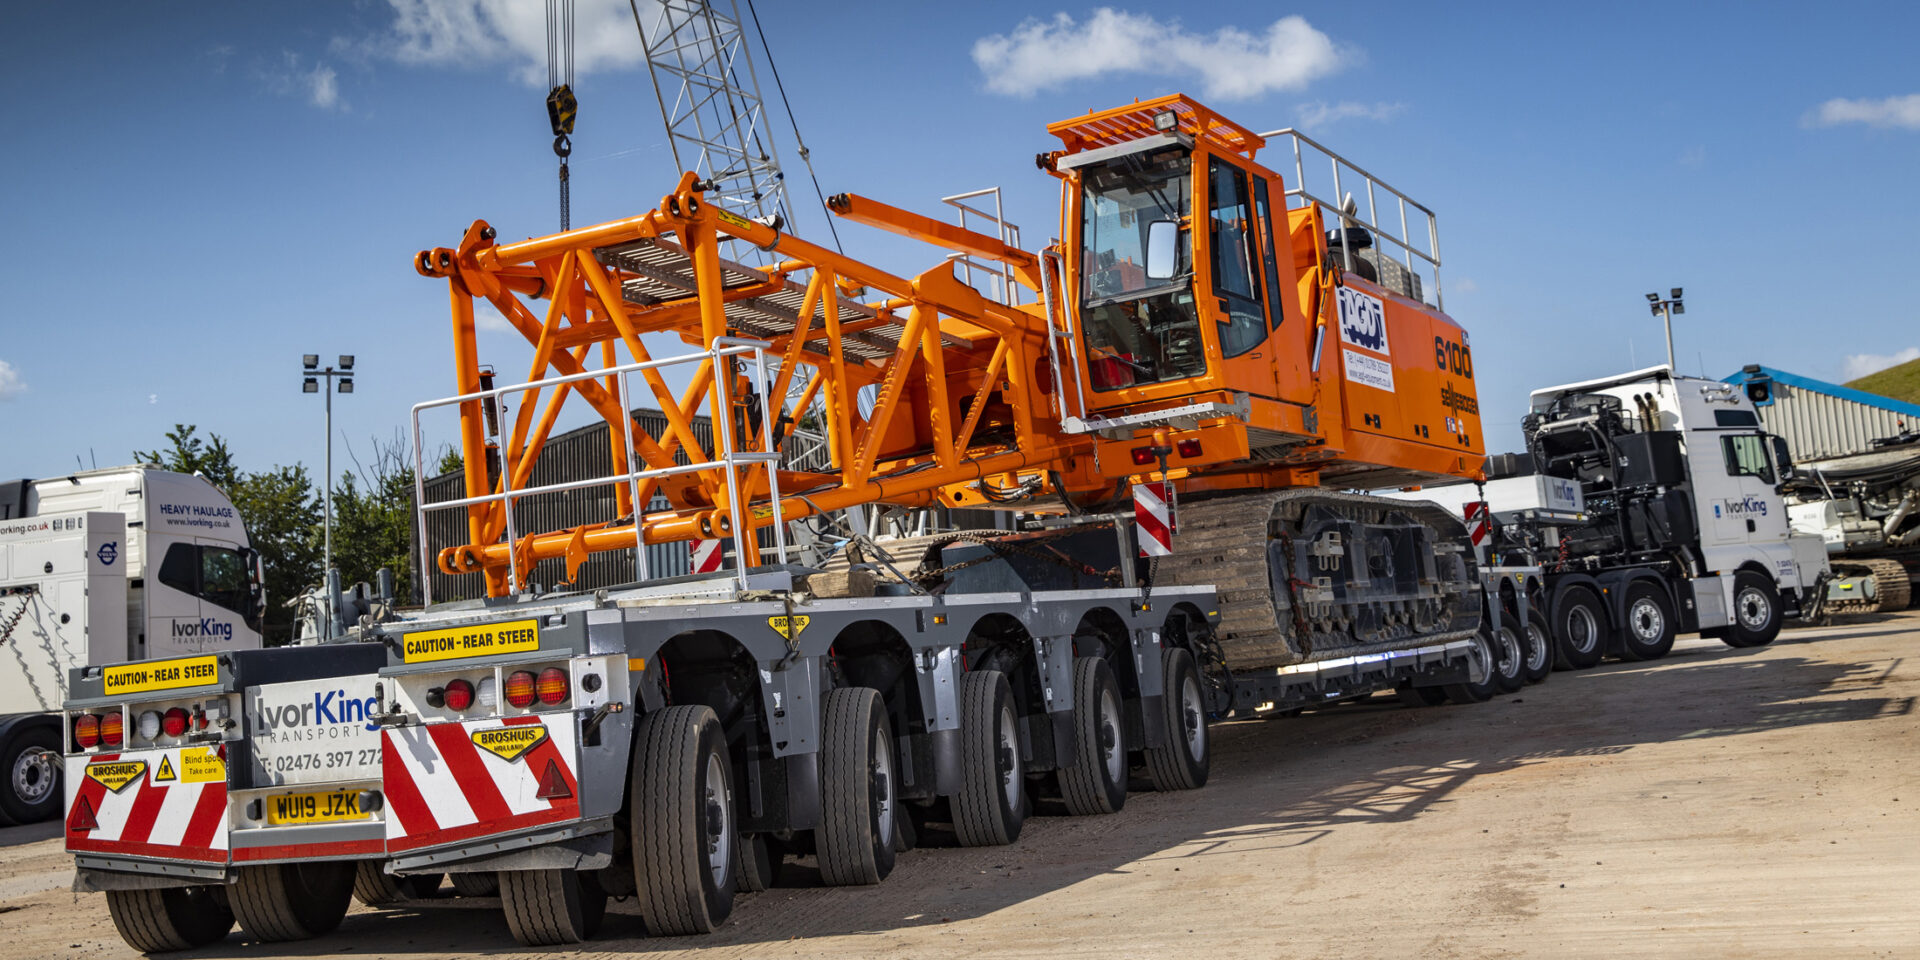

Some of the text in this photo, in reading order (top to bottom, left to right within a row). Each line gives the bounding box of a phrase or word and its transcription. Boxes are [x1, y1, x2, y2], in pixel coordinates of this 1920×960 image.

[1435, 336, 1472, 379] 6100
[160, 504, 233, 518] HEAVY HAULAGE
[1724, 498, 1767, 516] IvorKing
[167, 517, 230, 529] www.ivorking.co.uk
[172, 618, 232, 640] IvorKing
[773, 617, 806, 627] BROUIS
[172, 636, 223, 644] TRANSPORT
[498, 628, 535, 645] STEER
[184, 664, 215, 678] STEER
[257, 689, 381, 731] IvorKing
[259, 725, 360, 744] TRANSPORT
[481, 730, 536, 744] BROSHUIS
[494, 744, 524, 752] HOLLAND
[185, 755, 202, 764] Blind
[260, 757, 271, 773] T:
[276, 754, 321, 772] 02476
[326, 751, 353, 768] 397
[93, 764, 137, 776] BROSHUIS
[277, 793, 357, 819] WU19 JZK
